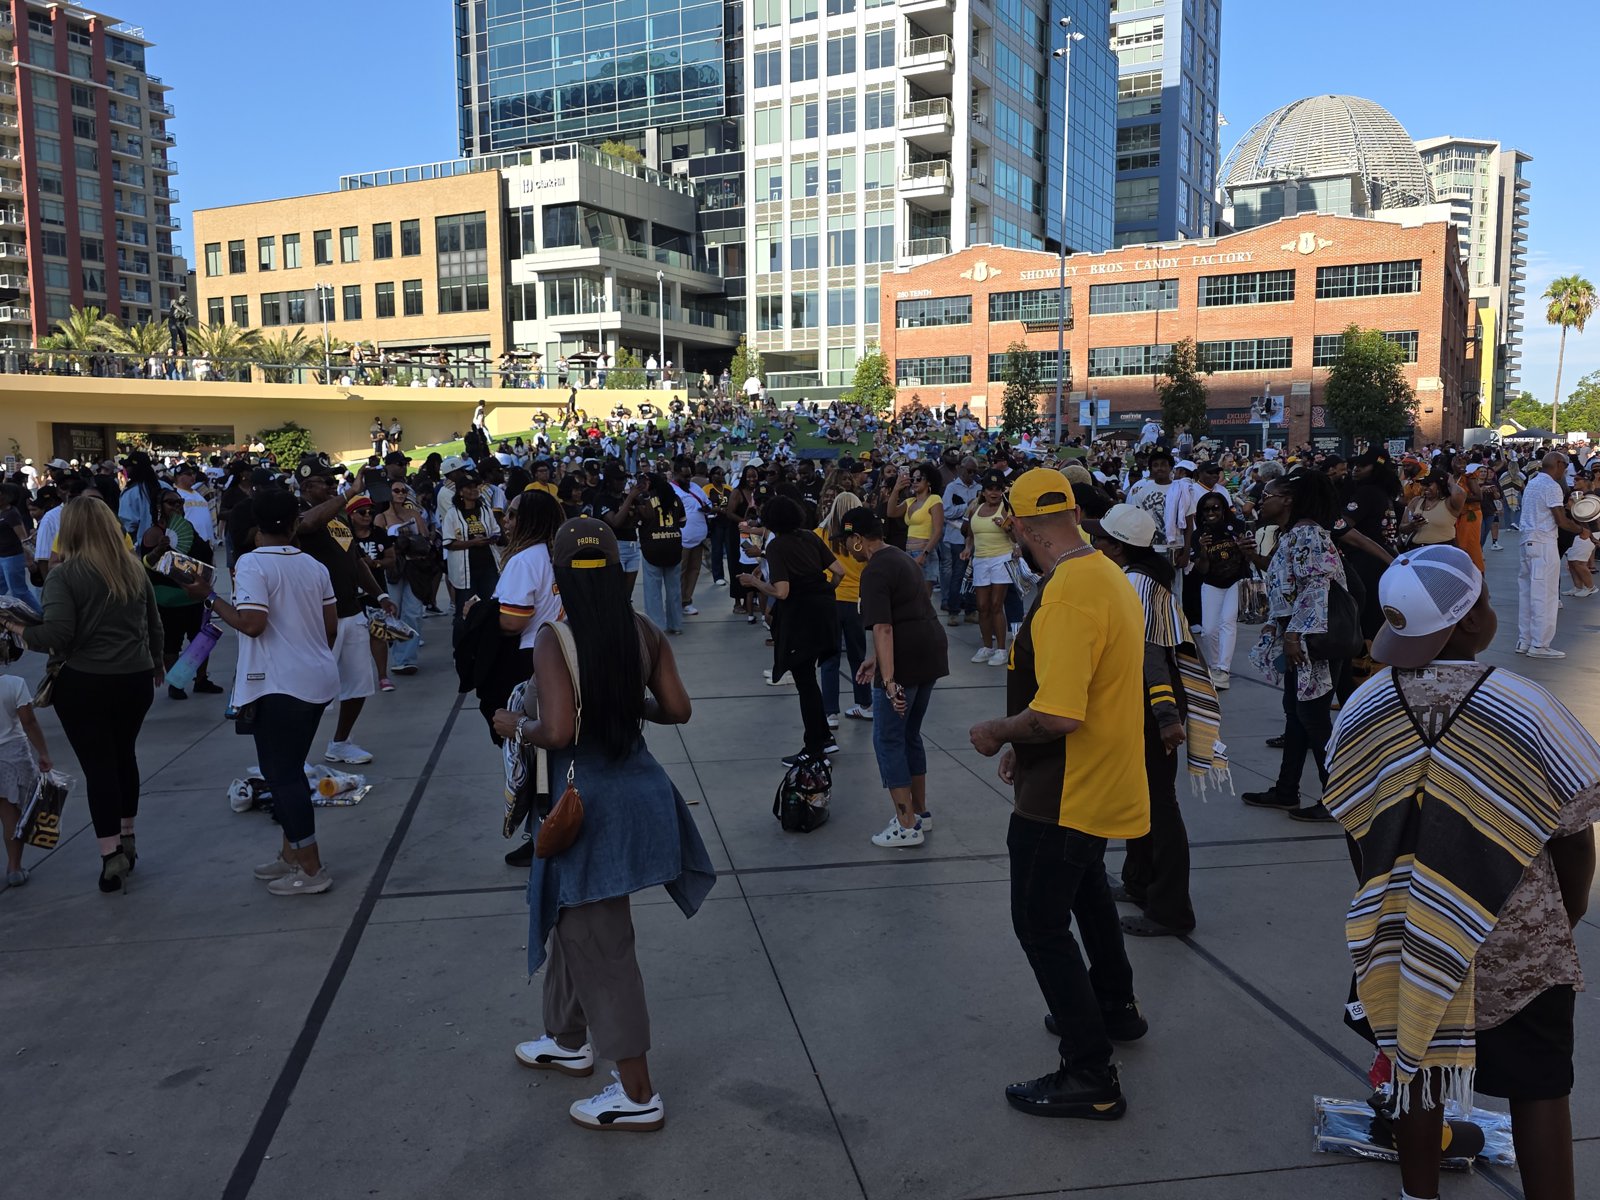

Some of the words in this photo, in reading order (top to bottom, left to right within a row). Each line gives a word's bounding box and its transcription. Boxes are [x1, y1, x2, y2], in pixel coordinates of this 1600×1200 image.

[1135, 257, 1180, 271] CANDY
[1192, 252, 1254, 266] FACTORY
[576, 536, 600, 546] PADRES
